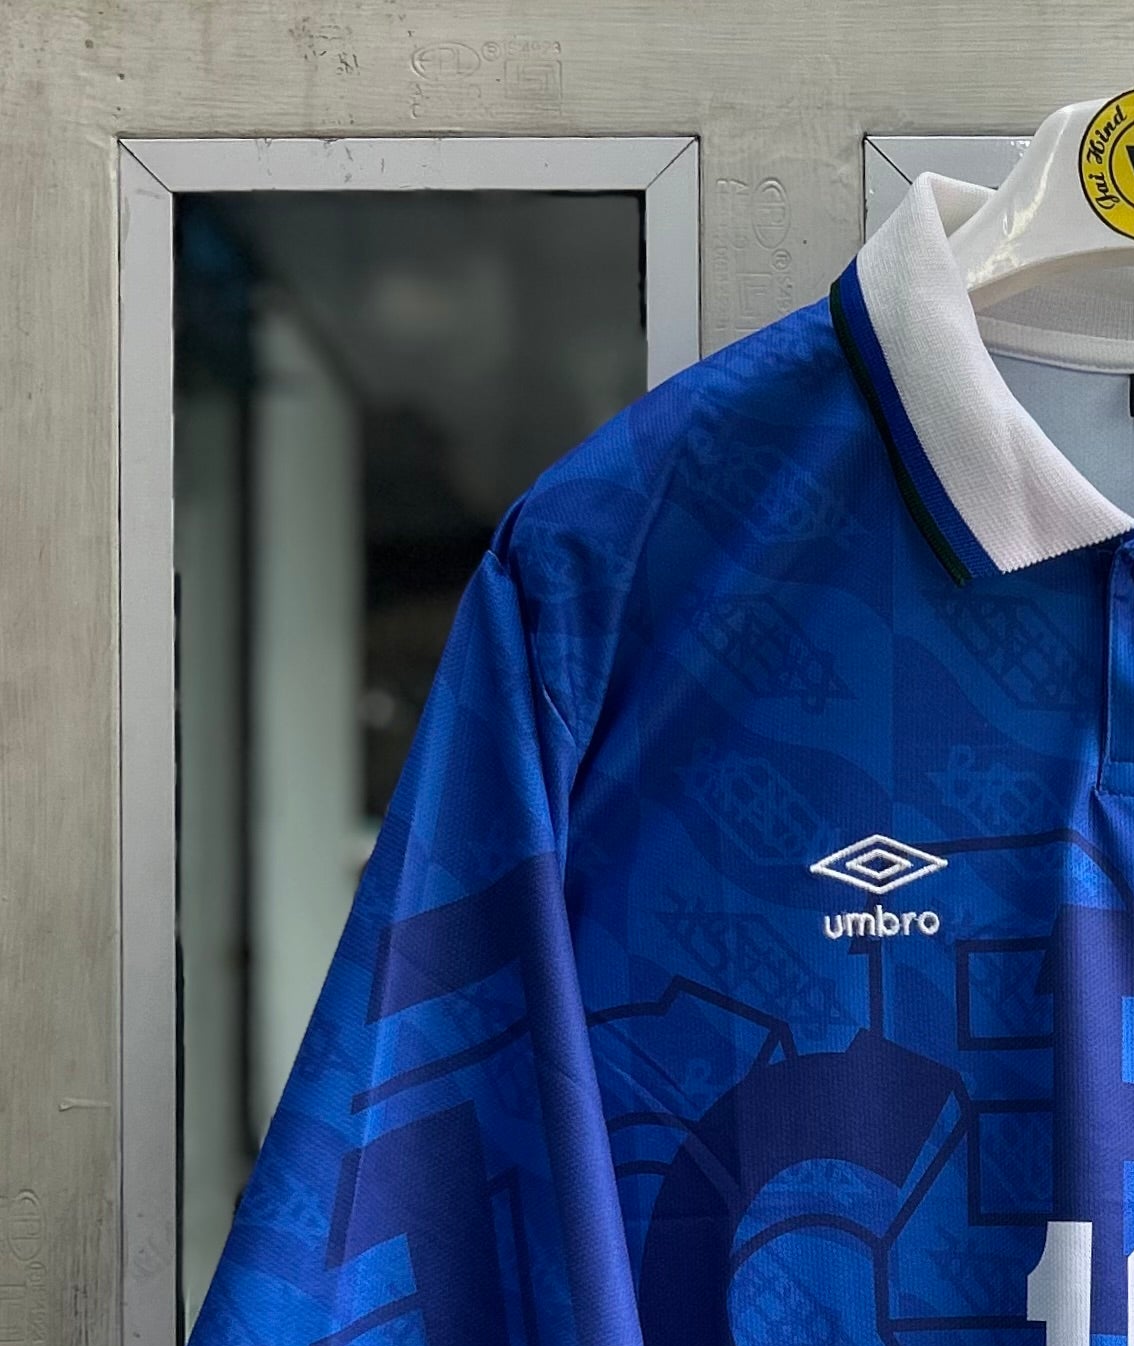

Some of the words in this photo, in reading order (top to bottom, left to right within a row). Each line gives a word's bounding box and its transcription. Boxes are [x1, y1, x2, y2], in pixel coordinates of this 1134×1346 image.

[1086, 104, 1128, 165] Hind
[1088, 173, 1121, 210] Jai
[824, 904, 940, 939] umbro
